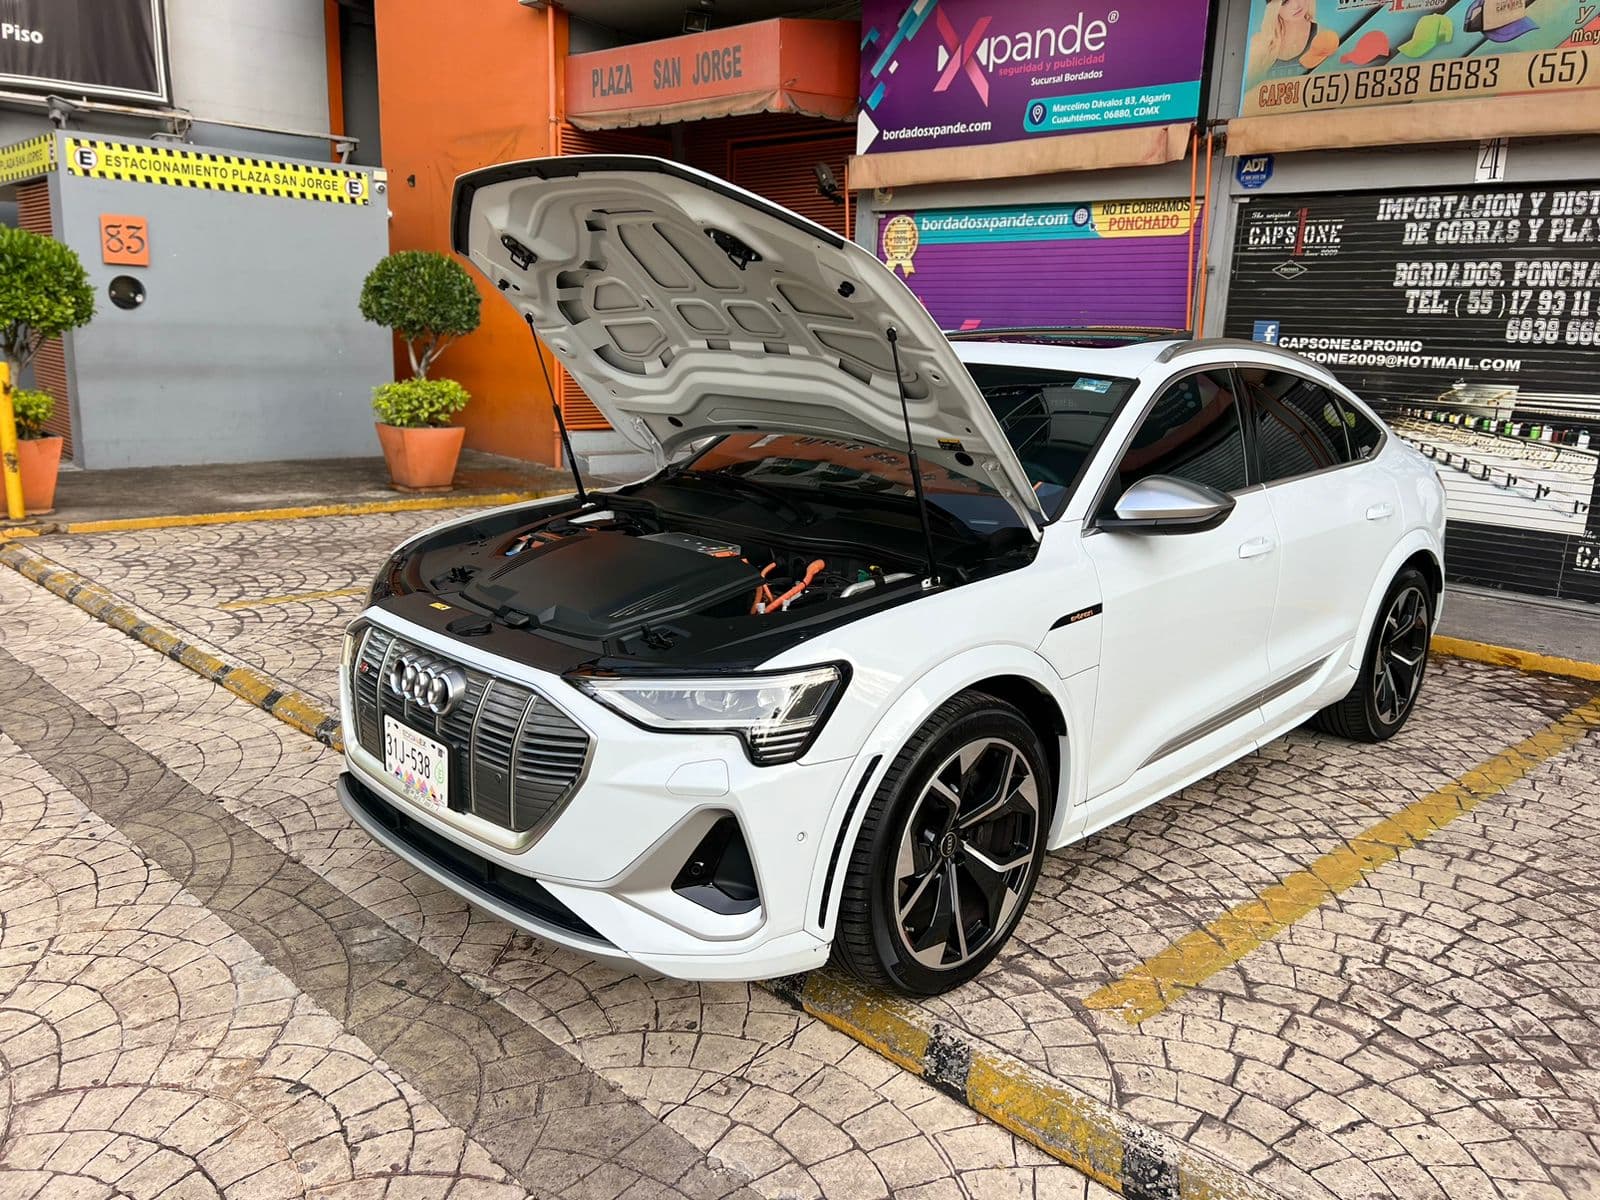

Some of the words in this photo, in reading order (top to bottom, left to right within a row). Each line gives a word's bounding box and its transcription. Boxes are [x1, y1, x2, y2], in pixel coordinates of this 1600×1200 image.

[1, 23, 44, 44] Piso
[592, 64, 633, 98] PLAZA
[653, 57, 682, 89] SAN
[692, 45, 742, 85] JORGE
[999, 62, 1043, 77] seguridad
[1045, 62, 1052, 71] y
[1053, 53, 1105, 71] publicidad
[1031, 73, 1063, 86] Sucursal
[1064, 69, 1103, 82] Bordados
[1303, 73, 1349, 108] (55)
[1355, 66, 1420, 99] 6838
[1429, 57, 1500, 92] 6683
[1528, 50, 1588, 88] (55)
[1052, 102, 1090, 113] Marcelino
[1134, 106, 1160, 117] CDMX
[883, 121, 992, 140] bordadosxpande.com
[79, 150, 93, 166] E
[105, 154, 228, 179] ESTACIONAMIENTO
[232, 169, 271, 184] PLAZA
[274, 173, 297, 187] SAN
[300, 178, 339, 191] JORGE
[348, 181, 360, 195] E
[1242, 158, 1268, 173] ADT
[1102, 203, 1117, 215] NO
[1120, 203, 1132, 214] TE
[1132, 199, 1190, 214] COBRAMOS
[1377, 192, 1524, 221] IMPORTACION
[1530, 191, 1546, 216] Y
[921, 212, 1069, 232] bordadosxpande.com
[1108, 214, 1179, 231] PONCHADO
[1402, 221, 1430, 245] DE
[1435, 219, 1521, 245] GORRAS
[1528, 218, 1544, 243] Y
[1548, 217, 1600, 243] PLA
[105, 224, 145, 254] 83
[1393, 261, 1505, 287] BORDADOS,
[1405, 289, 1449, 314] TEL:
[1509, 289, 1533, 315] 17
[1537, 290, 1566, 316] 93
[1570, 290, 1591, 317] 11
[1505, 317, 1559, 345] 6838
[1279, 336, 1422, 353] CAPSONE&PROMO
[386, 732, 431, 780] 31J-538
